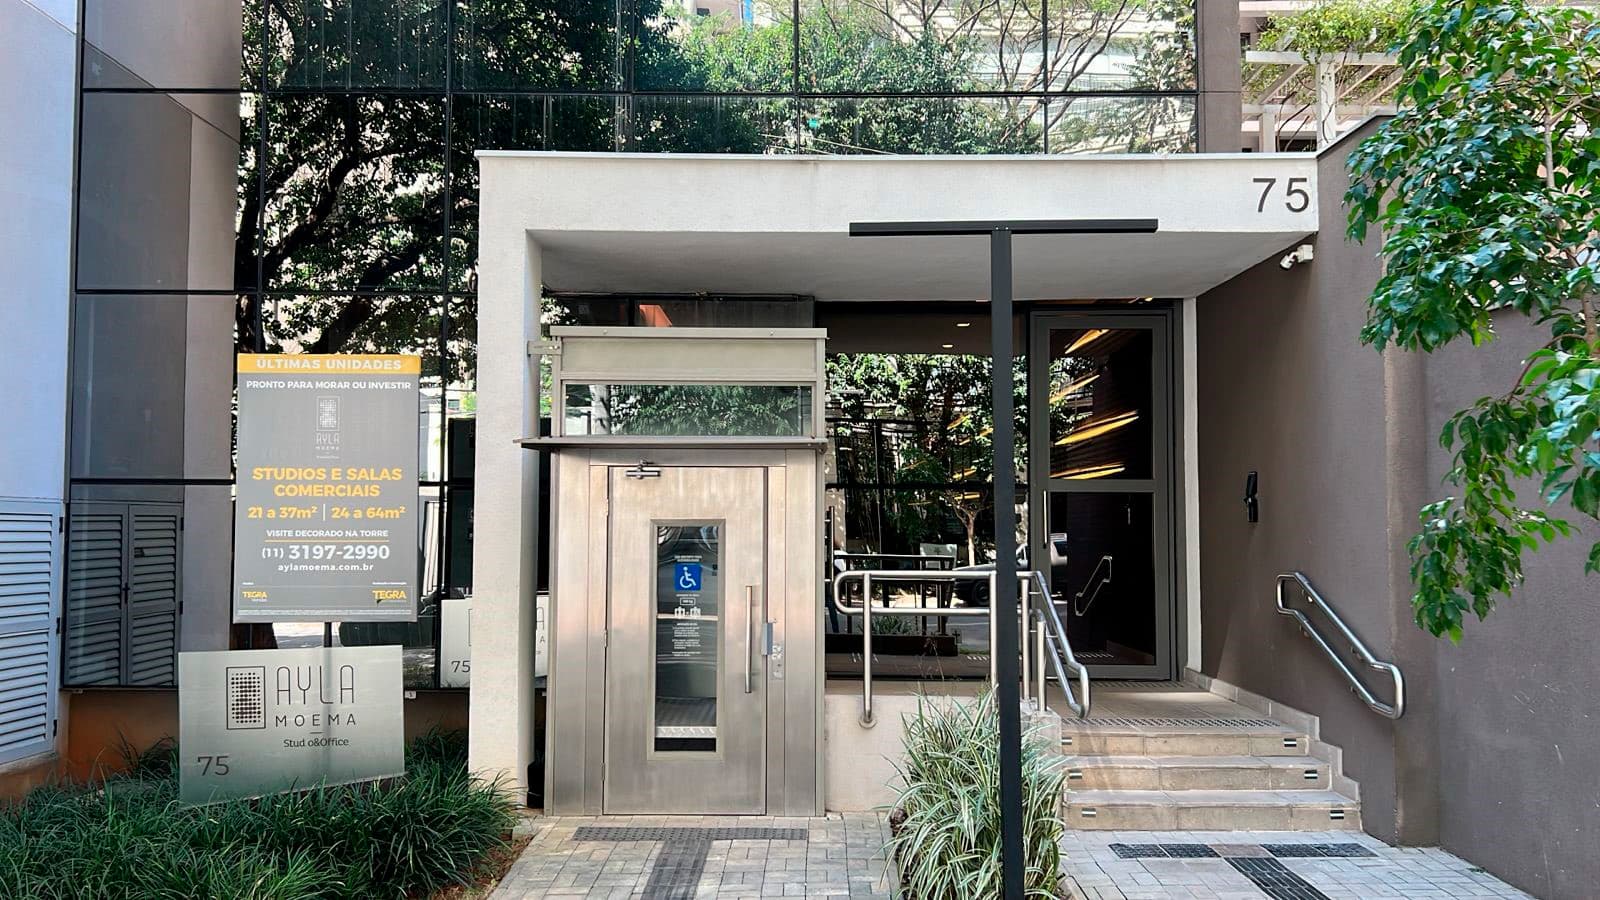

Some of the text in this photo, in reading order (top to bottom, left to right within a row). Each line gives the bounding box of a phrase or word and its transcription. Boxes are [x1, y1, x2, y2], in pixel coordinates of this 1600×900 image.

[1253, 177, 1309, 213] 75
[257, 357, 402, 370] ÚLTIMAS UNIDADES
[246, 380, 412, 390] PRONTO PARA MORAR OU INVESTIR
[316, 432, 340, 445] AYLA
[252, 467, 402, 481] STUDIOS E SALAS
[274, 484, 381, 497] COMERCIAIS
[248, 506, 406, 519] 21 a 37m² 24 a 64m²
[262, 545, 390, 560] (11) 3197-2990
[278, 563, 374, 572] aylamoema.com.br
[242, 591, 268, 599] TEGRA
[372, 590, 408, 600] TEGRA
[451, 661, 471, 673] 75
[276, 665, 354, 705] AYLA
[275, 713, 356, 728] MOEMA
[198, 755, 230, 776] 75
